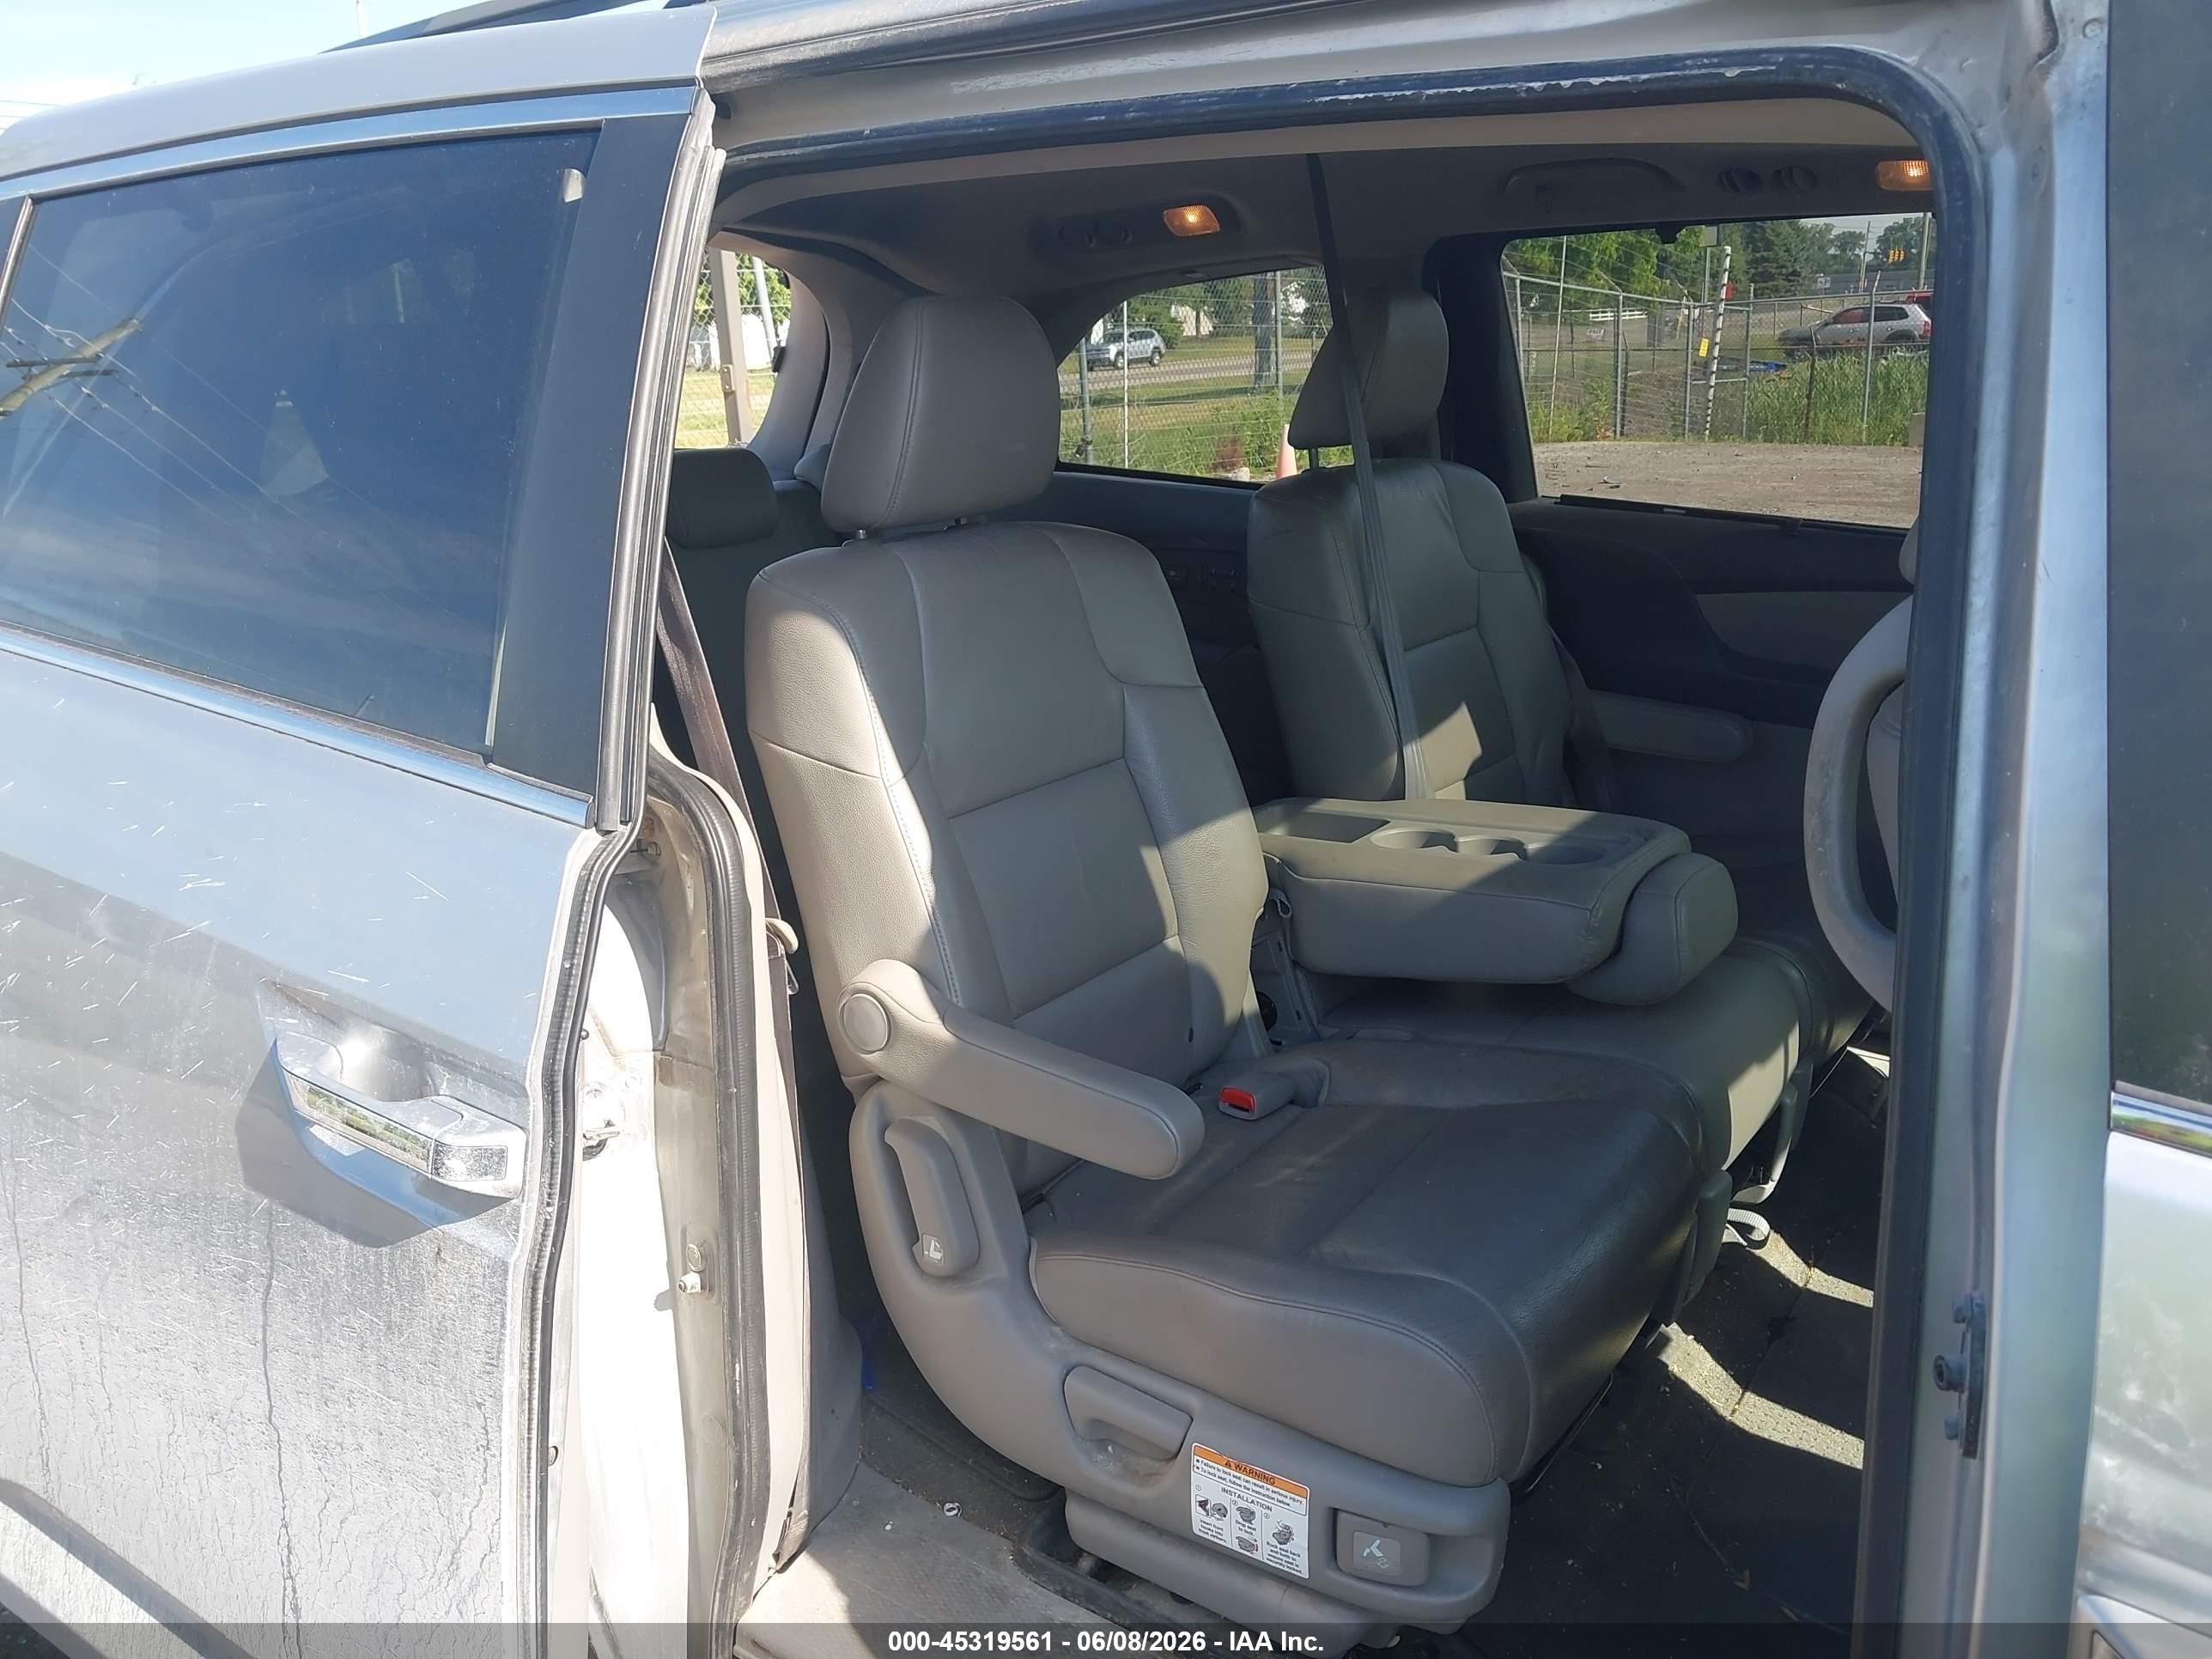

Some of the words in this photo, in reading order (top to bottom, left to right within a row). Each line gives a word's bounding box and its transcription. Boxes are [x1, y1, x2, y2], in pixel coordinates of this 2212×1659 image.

[1201, 1460, 1216, 1470] Failure
[1271, 1489, 1288, 1498] serious
[1234, 1462, 1276, 1485] WARNING
[1221, 1486, 1272, 1511] INSTALLATION
[1229, 1479, 1243, 1487] follow
[1251, 1487, 1275, 1501] instruction
